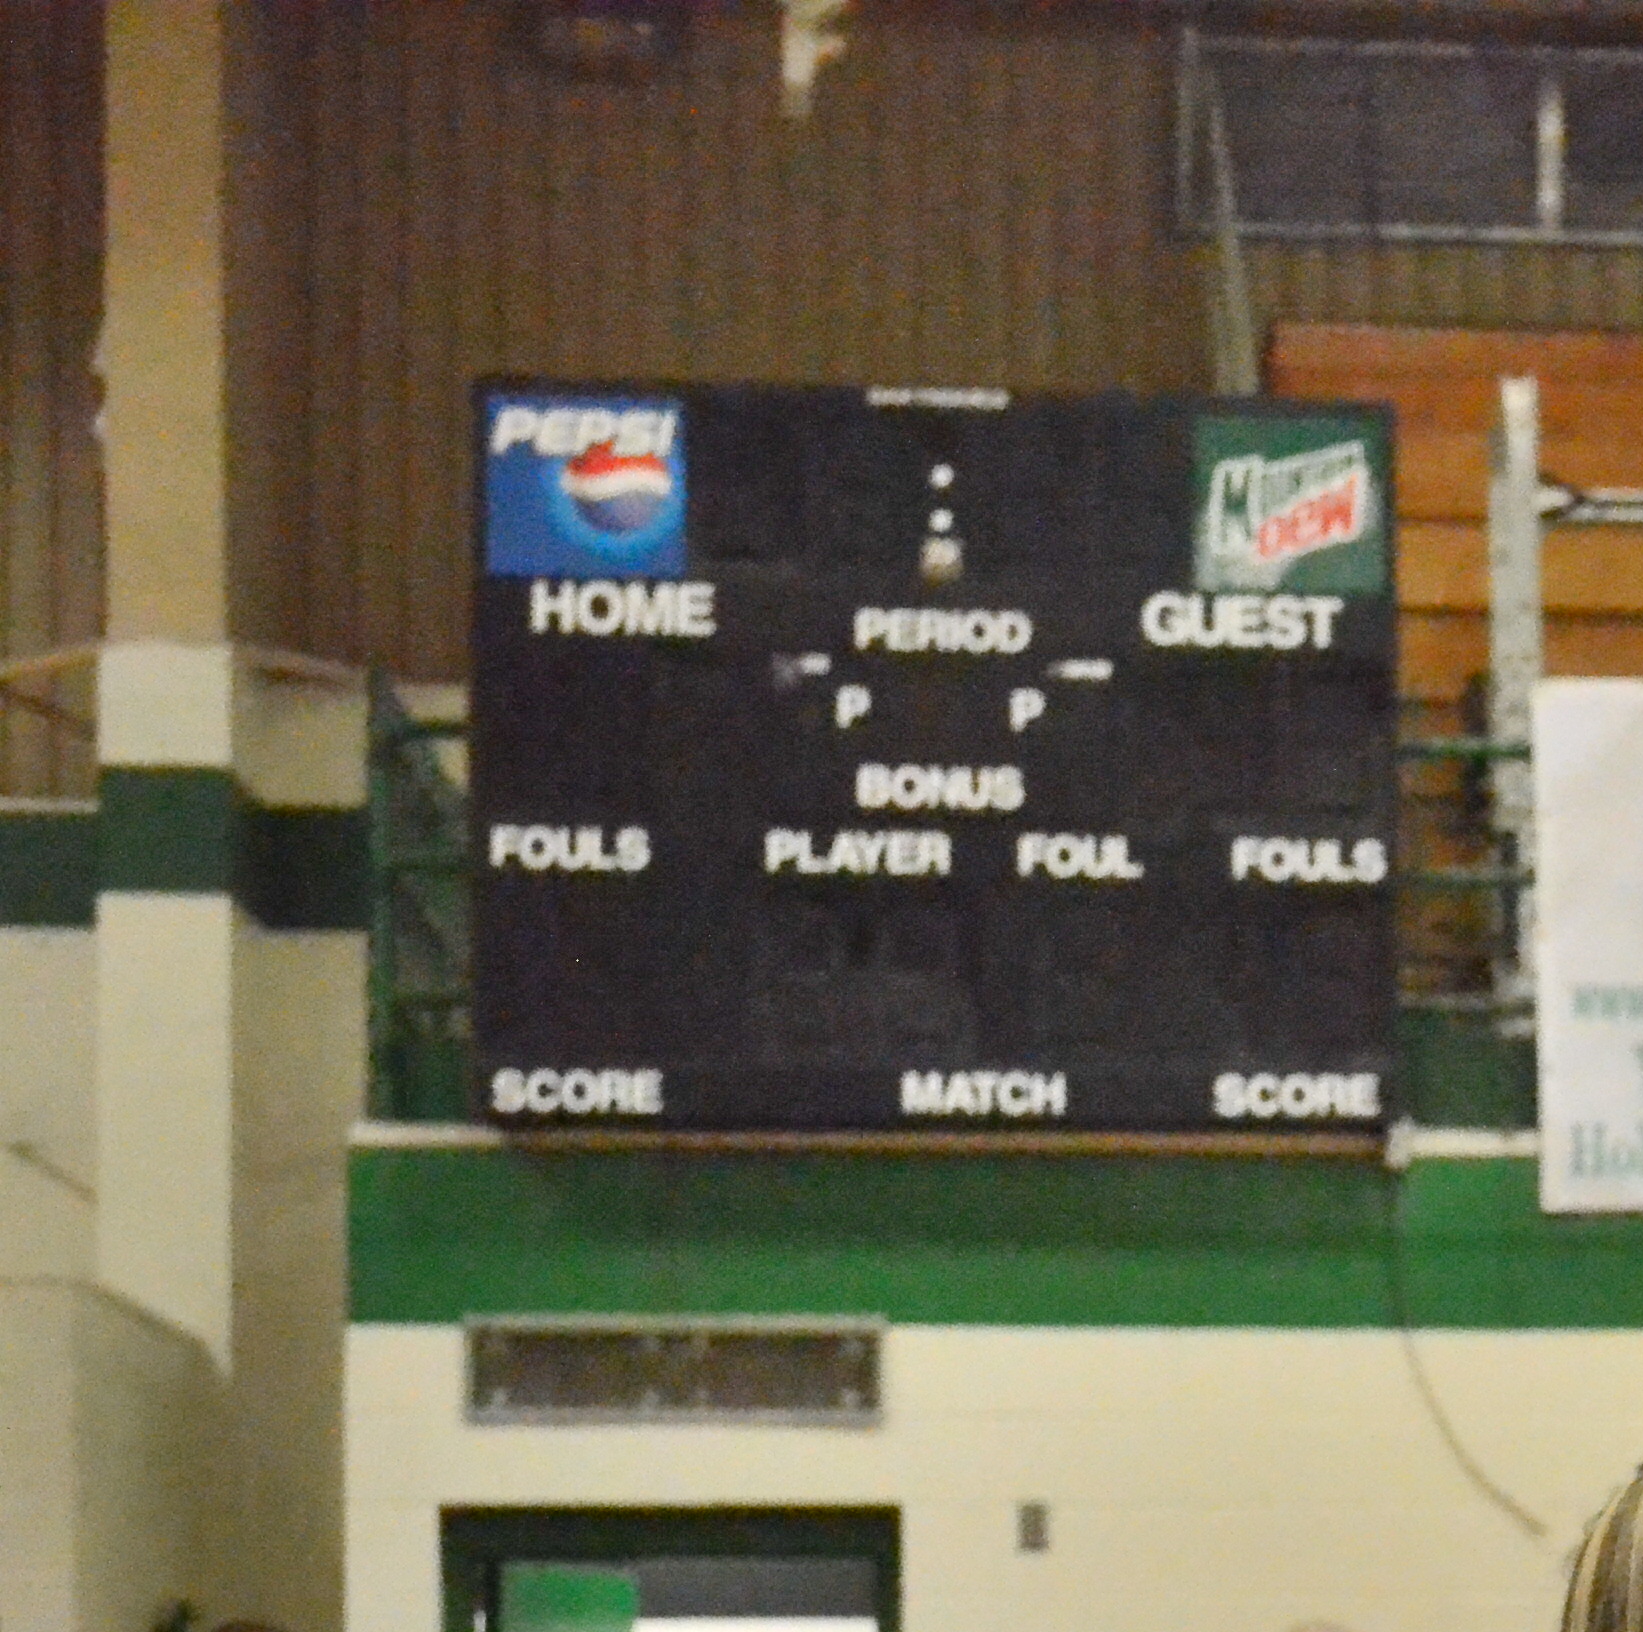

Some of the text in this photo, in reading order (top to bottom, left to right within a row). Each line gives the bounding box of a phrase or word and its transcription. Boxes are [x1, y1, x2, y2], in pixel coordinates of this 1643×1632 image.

[490, 405, 676, 455] PEPSI
[531, 580, 716, 636] HOME
[854, 607, 1033, 653] PERIOD
[1141, 590, 1344, 650] GUEST
[836, 685, 871, 728] P
[1010, 688, 1045, 731] P
[856, 764, 1025, 811] BONUS
[490, 825, 650, 871] FOULS
[765, 828, 951, 875] PLAYER
[1017, 833, 1144, 879] FOUL
[1231, 836, 1387, 883] FOULS
[492, 1069, 662, 1113] SCORE
[901, 1070, 1067, 1116] MATCH
[1213, 1072, 1380, 1117] SCORE
